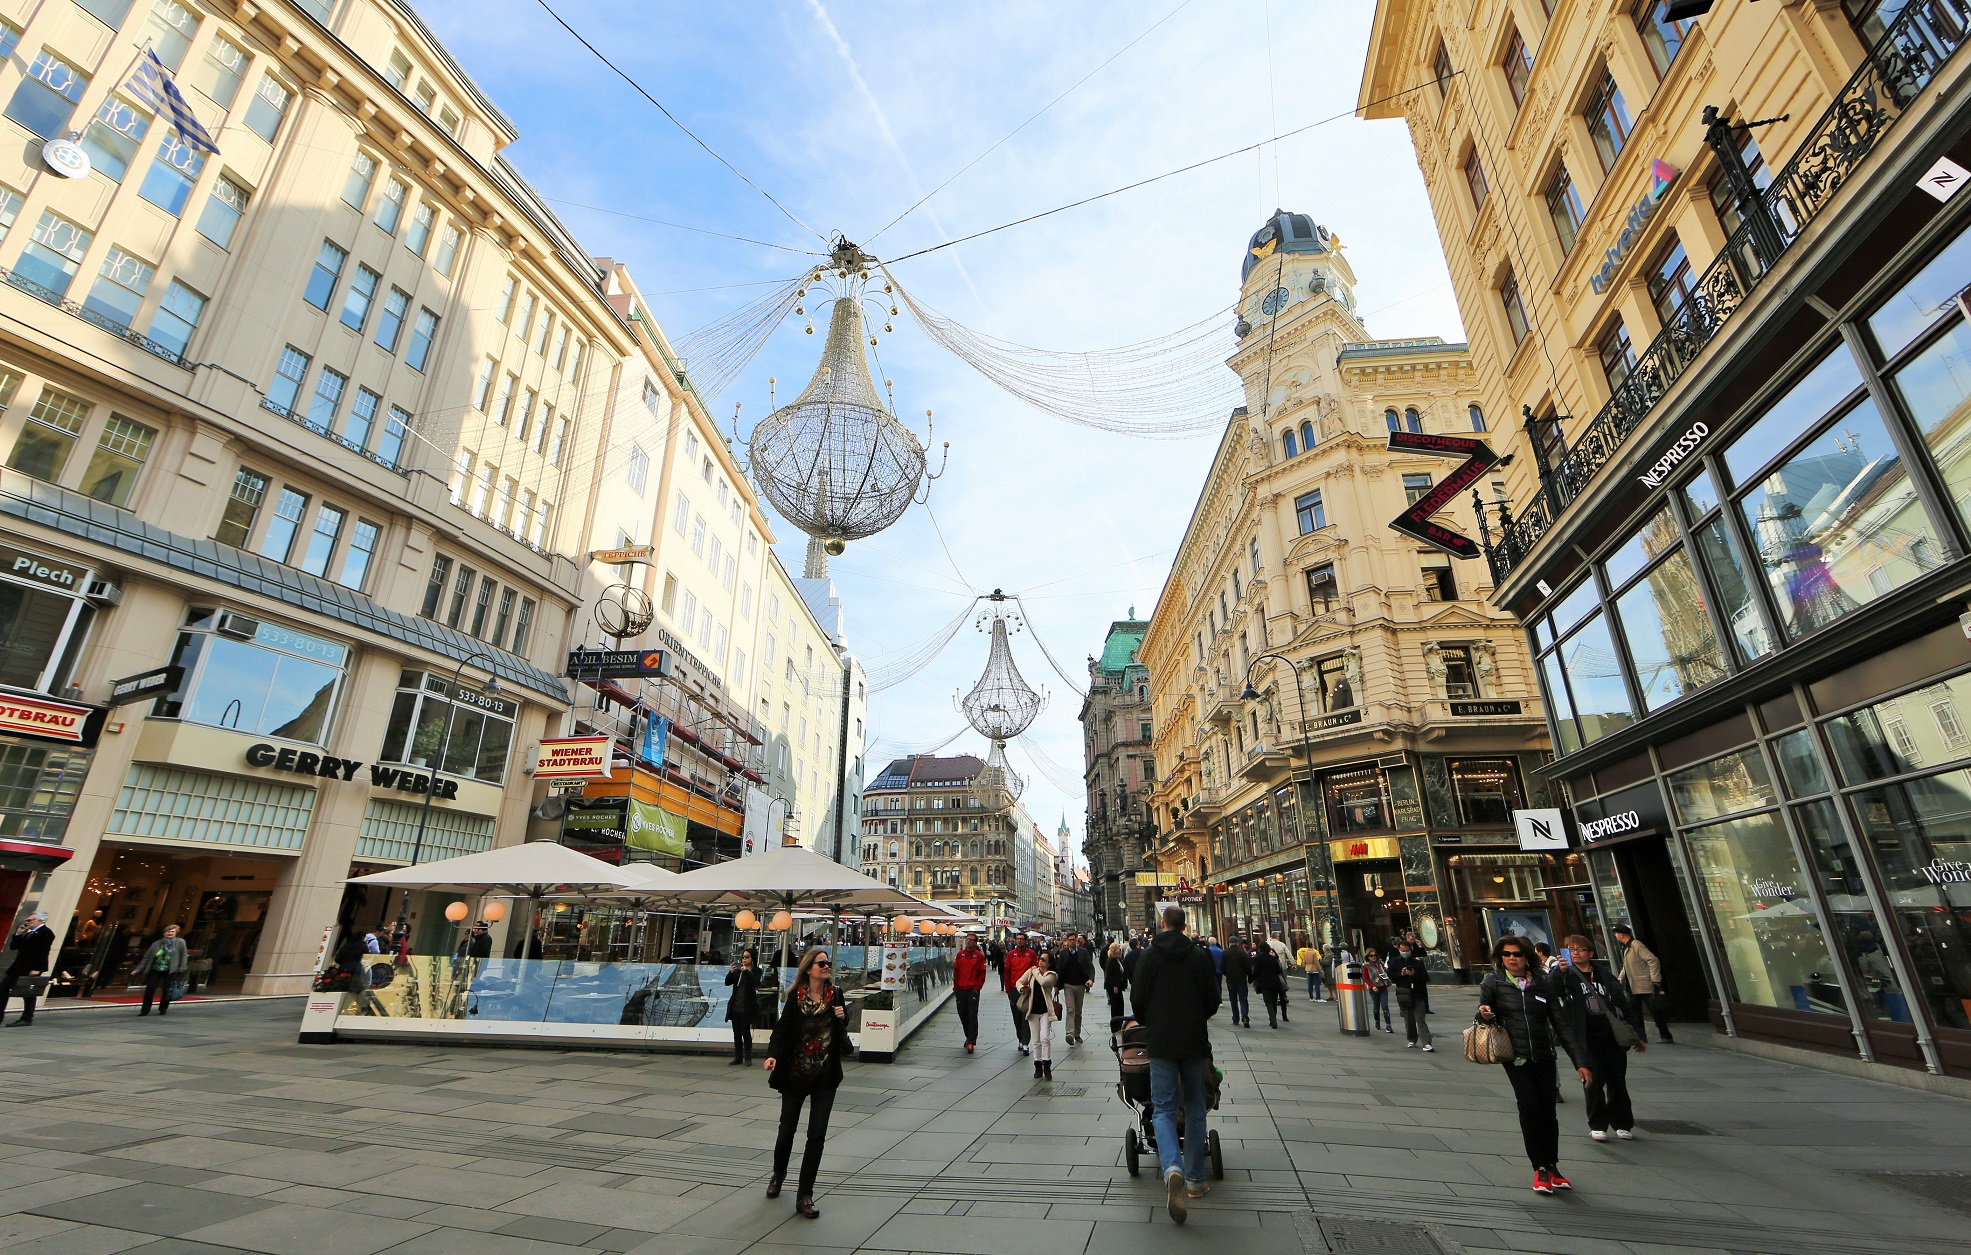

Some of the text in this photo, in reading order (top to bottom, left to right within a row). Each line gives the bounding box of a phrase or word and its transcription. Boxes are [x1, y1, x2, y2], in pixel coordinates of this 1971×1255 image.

[1589, 192, 1652, 296] helvetia
[1395, 433, 1477, 448] DISCOTHEQUE
[1637, 421, 1709, 490] NESPRESSO
[1411, 461, 1487, 523] FLEDERMAUS
[1428, 526, 1452, 541] BAR
[602, 550, 646, 559] TEPPICHE
[12, 556, 74, 585] Plech
[602, 654, 638, 664] BESIM
[114, 673, 167, 695] GERRY WEBER
[1467, 704, 1495, 713] BRAUN
[1313, 717, 1337, 729] BRAUN
[551, 747, 593, 757] WIENER
[538, 756, 603, 767] STADTBRÄU
[245, 743, 459, 800] GERRY WEBER
[1578, 810, 1640, 843] NESPRESSO
[1931, 857, 1964, 873] Give
[1755, 877, 1774, 889] Give
